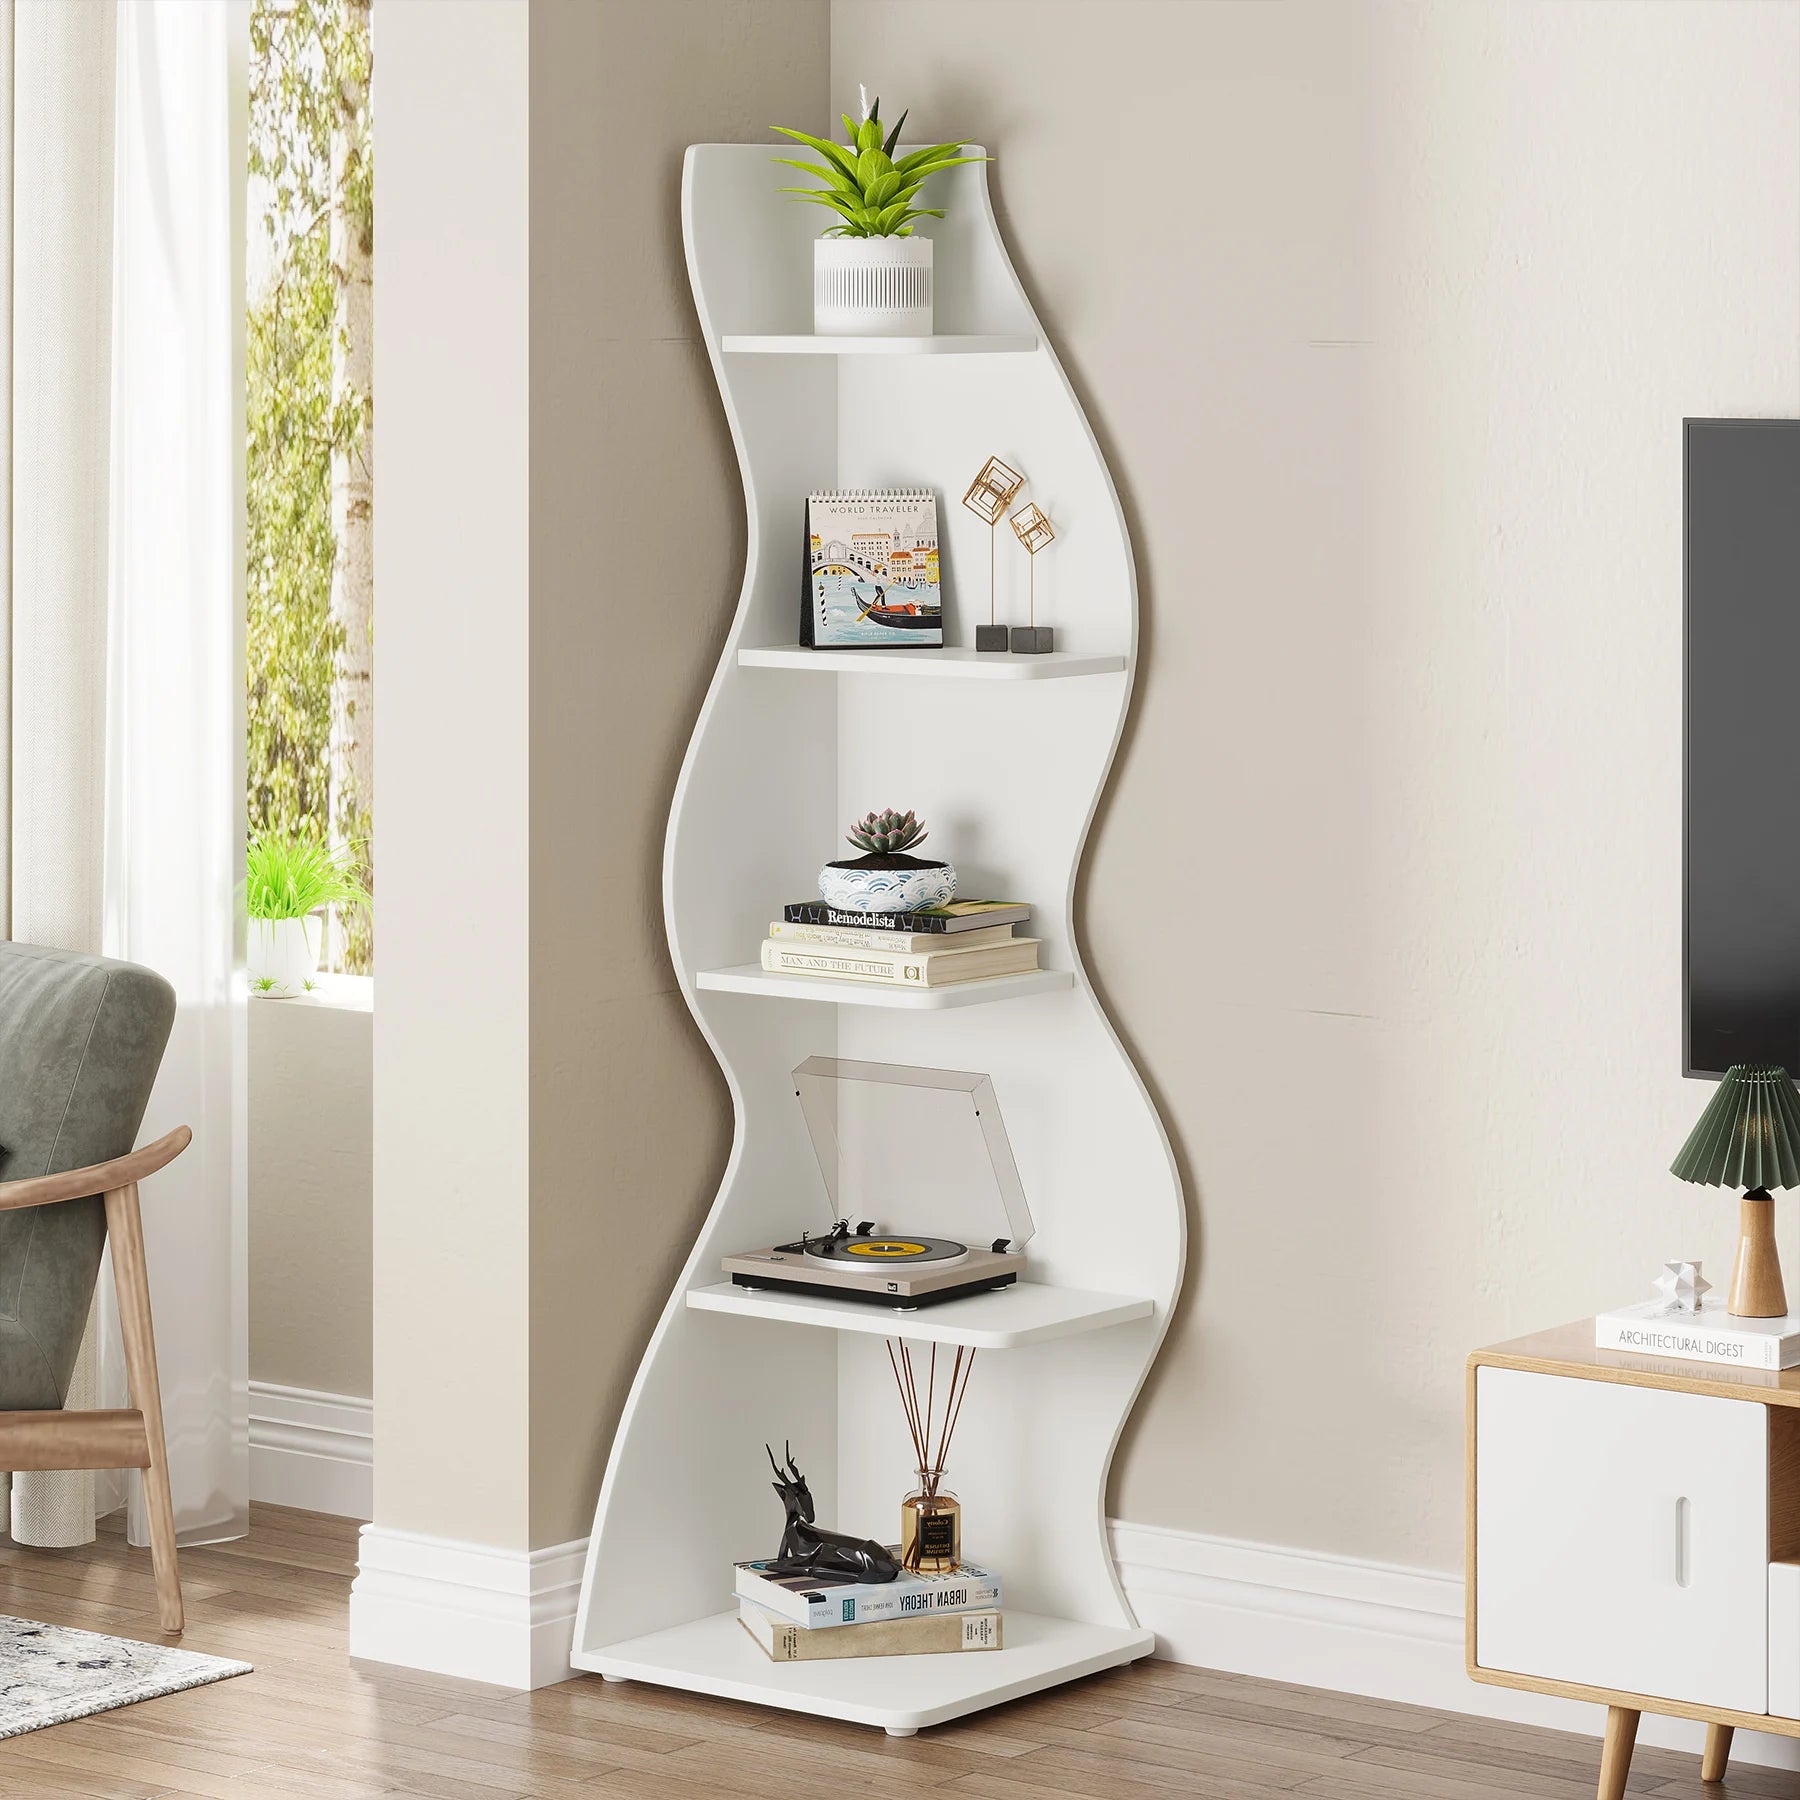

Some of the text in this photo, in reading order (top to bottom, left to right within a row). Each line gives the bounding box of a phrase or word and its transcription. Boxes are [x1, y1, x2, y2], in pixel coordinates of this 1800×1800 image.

[829, 505, 919, 514] WORLD TRAVELER
[827, 910, 896, 928] Remodelista
[781, 956, 894, 975] MAN AND THE FUTURE
[1619, 1330, 1703, 1353] ARCHITECTURAL
[1706, 1340, 1744, 1358] DIGEST
